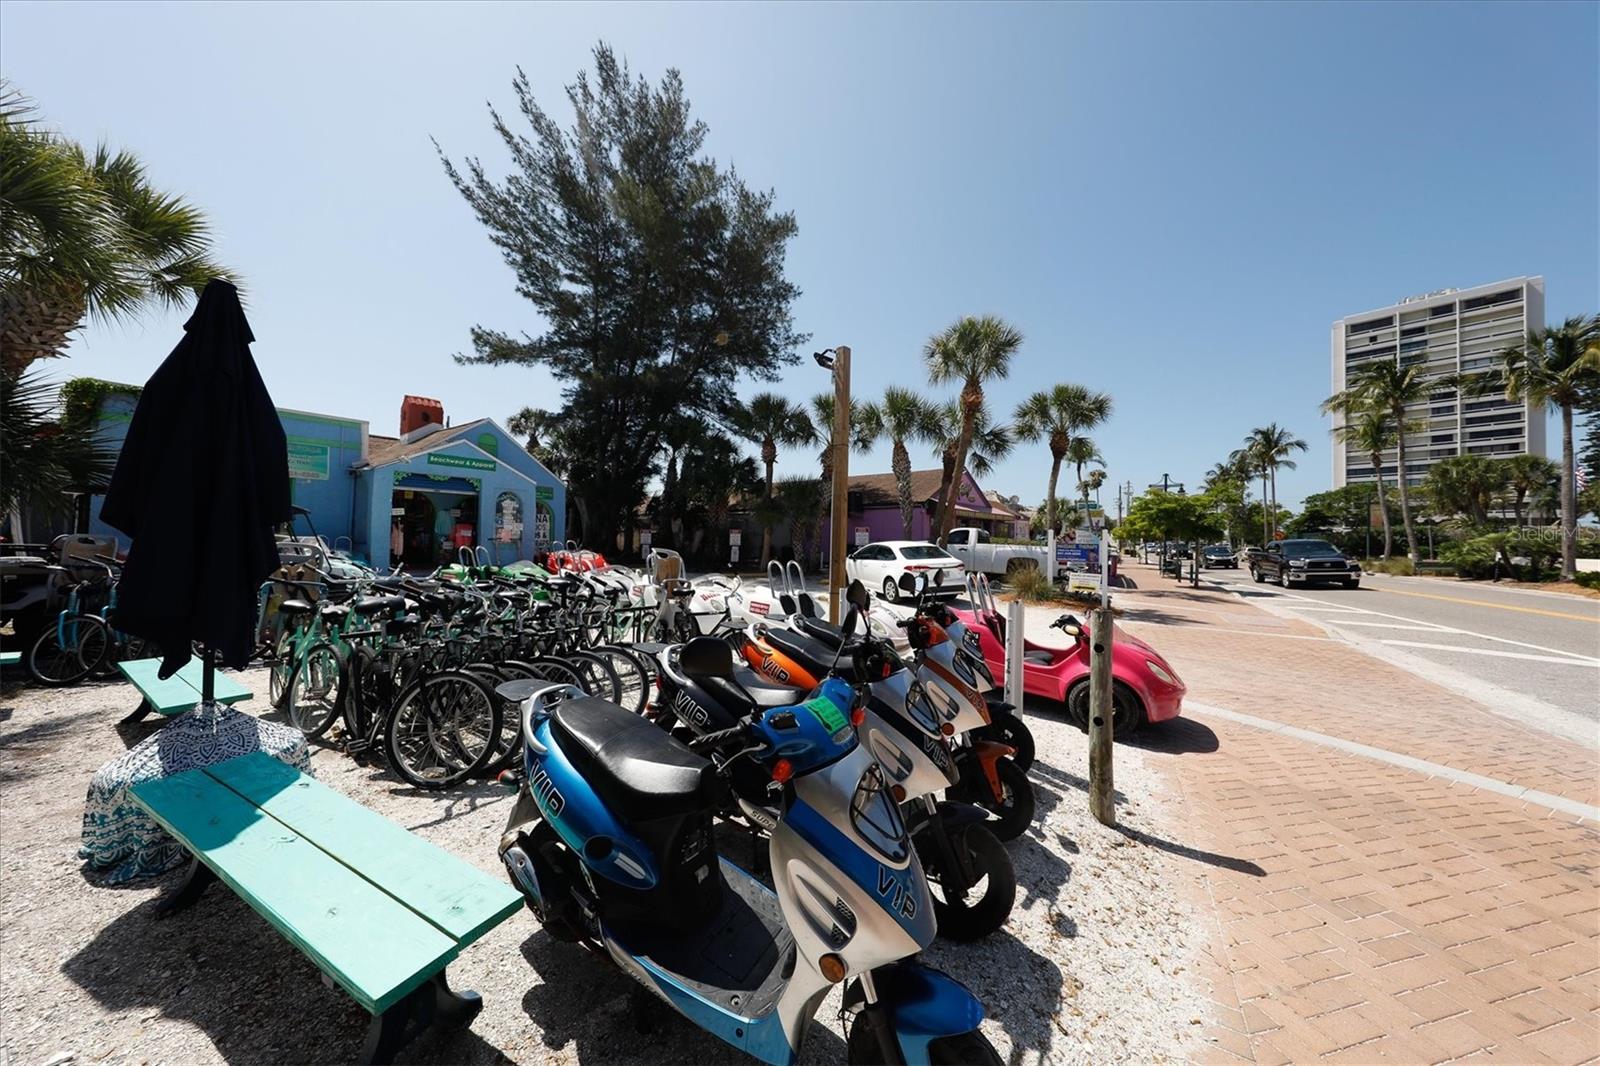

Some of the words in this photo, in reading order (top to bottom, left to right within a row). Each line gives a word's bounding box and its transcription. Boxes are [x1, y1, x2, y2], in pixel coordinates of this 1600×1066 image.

[430, 456, 465, 465] Beachwear
[472, 461, 495, 469] Apparel
[762, 655, 790, 683] VIP
[675, 689, 708, 726] VIP
[923, 734, 949, 768] VIP
[530, 759, 565, 819] VIP
[877, 864, 917, 920] VIP
